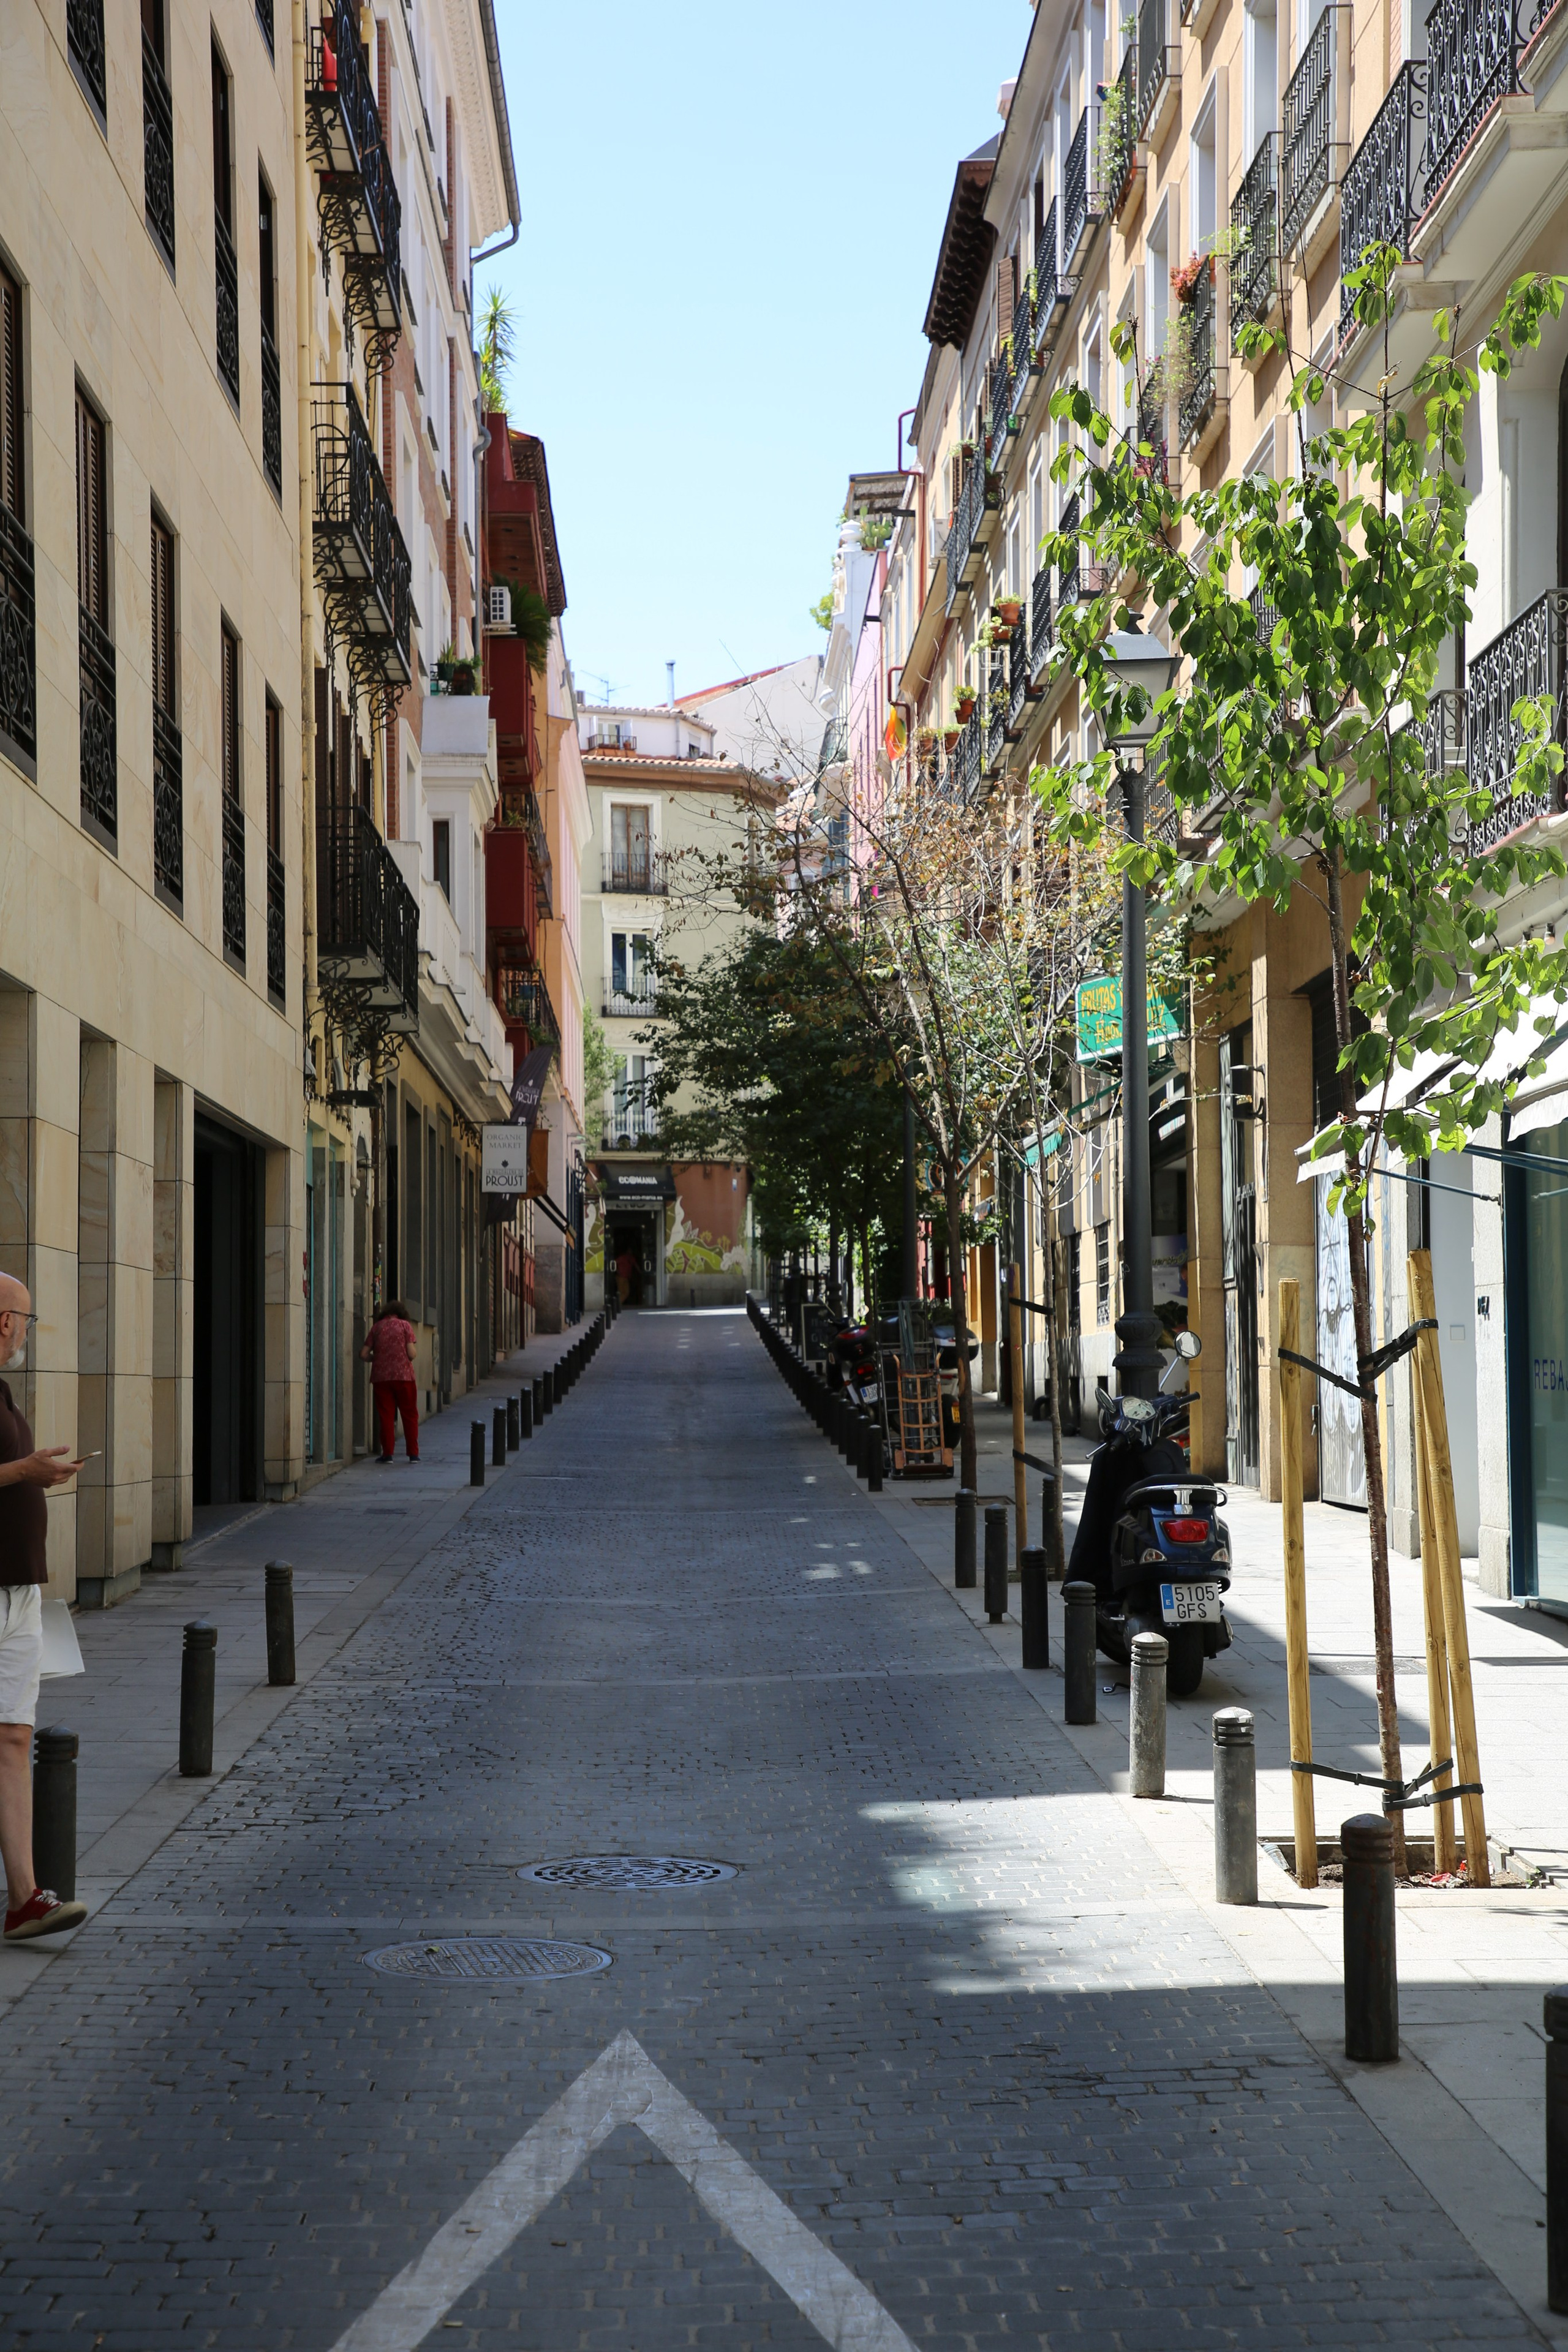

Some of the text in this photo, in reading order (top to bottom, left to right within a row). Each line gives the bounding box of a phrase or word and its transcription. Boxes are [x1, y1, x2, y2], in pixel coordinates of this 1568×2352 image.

[1081, 984, 1117, 1018] FRUTAS
[486, 1175, 524, 1186] PROUST
[1174, 1586, 1215, 1602] 5105
[1177, 1603, 1207, 1619] GFS
